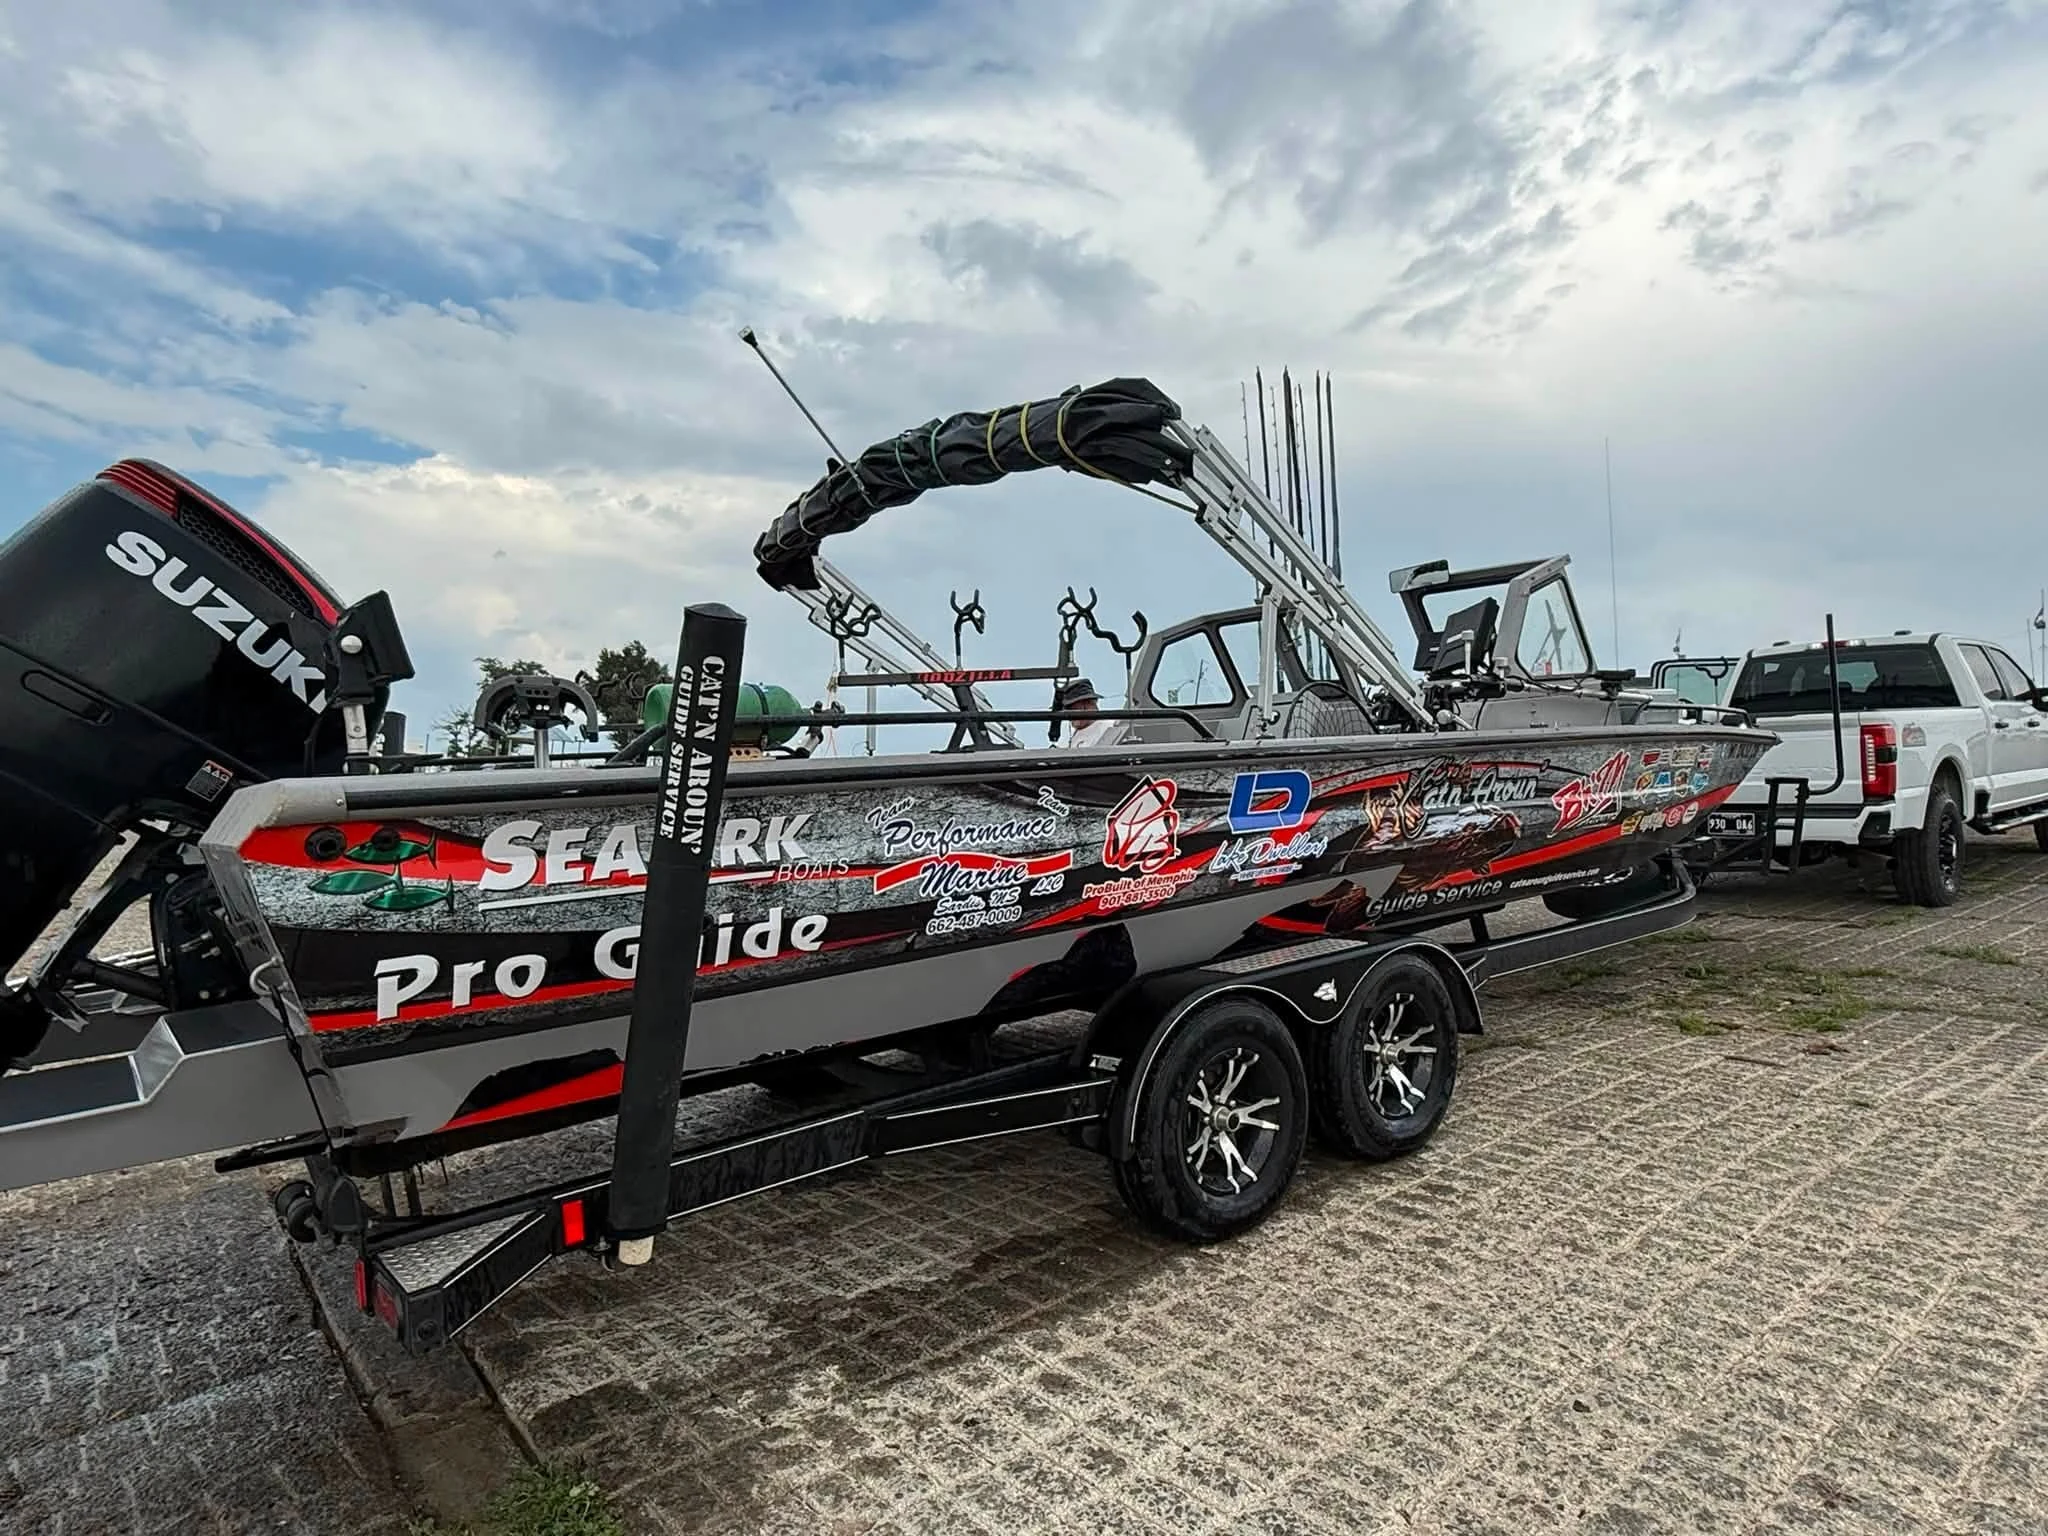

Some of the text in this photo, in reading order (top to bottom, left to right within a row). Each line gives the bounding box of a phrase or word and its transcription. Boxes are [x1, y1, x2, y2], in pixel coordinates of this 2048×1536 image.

[659, 665, 694, 839] GUIDE SERVICE
[680, 655, 726, 854] CAT'N AROUN'
[866, 797, 914, 828] Team
[479, 813, 814, 892] SEARK
[882, 817, 1055, 859] Performance
[1209, 837, 1248, 874] Lake
[1245, 832, 1328, 864] Dwellers
[775, 857, 849, 883] BOATS
[920, 861, 1029, 896] Marine
[1083, 870, 1197, 898] ProBuilt of Memphis
[1365, 879, 1503, 918] Guide Service
[926, 906, 1022, 935] 662-487-0009
[373, 907, 829, 1021] Pro Gide
